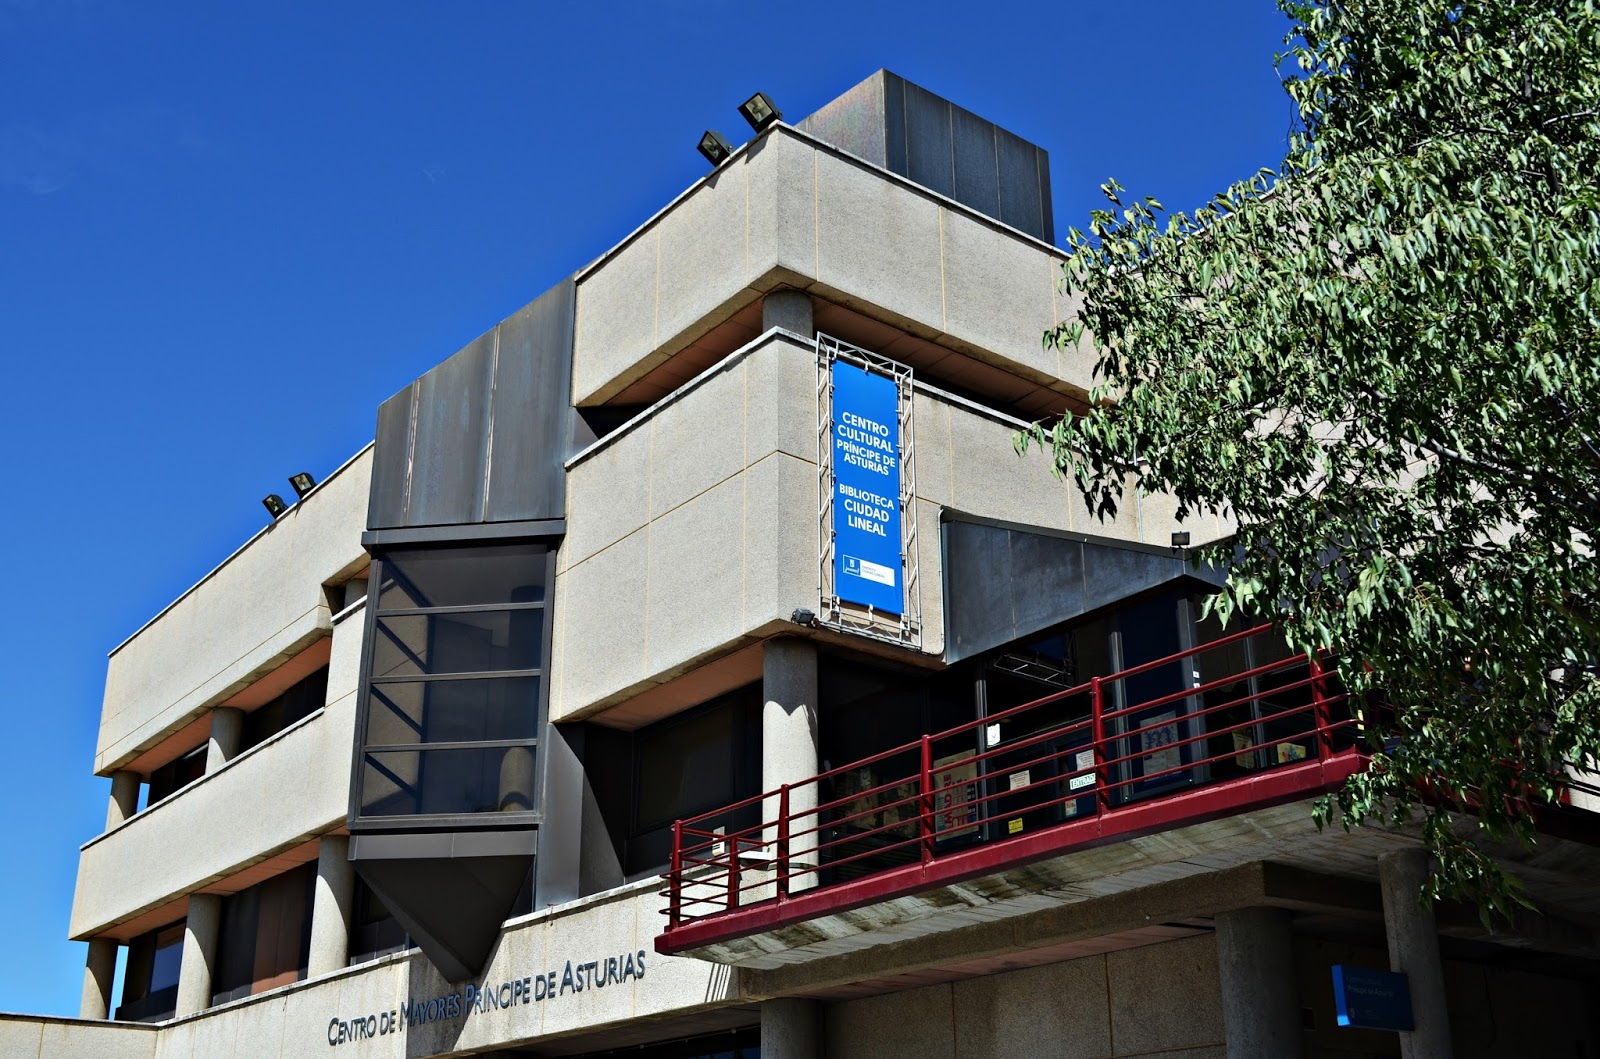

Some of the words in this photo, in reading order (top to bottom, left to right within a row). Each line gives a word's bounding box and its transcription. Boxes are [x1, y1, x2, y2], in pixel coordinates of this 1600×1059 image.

[842, 412, 889, 437] CENTRO
[837, 424, 894, 453] CULTURAL
[837, 439, 881, 463] PRÍNCIPE
[883, 454, 896, 468] DE
[844, 452, 889, 476] ASTURIAS
[839, 483, 895, 510] BIBLIOTECA
[844, 499, 890, 522] CIUDAD
[848, 514, 887, 537] LINEAL
[328, 1014, 377, 1046] CENTRO
[380, 1010, 397, 1036] DE
[399, 994, 461, 1032] MAYORES
[464, 977, 531, 1016] PRÍNCIPE
[535, 971, 556, 1001] DE
[560, 950, 646, 996] ASTURIAS
